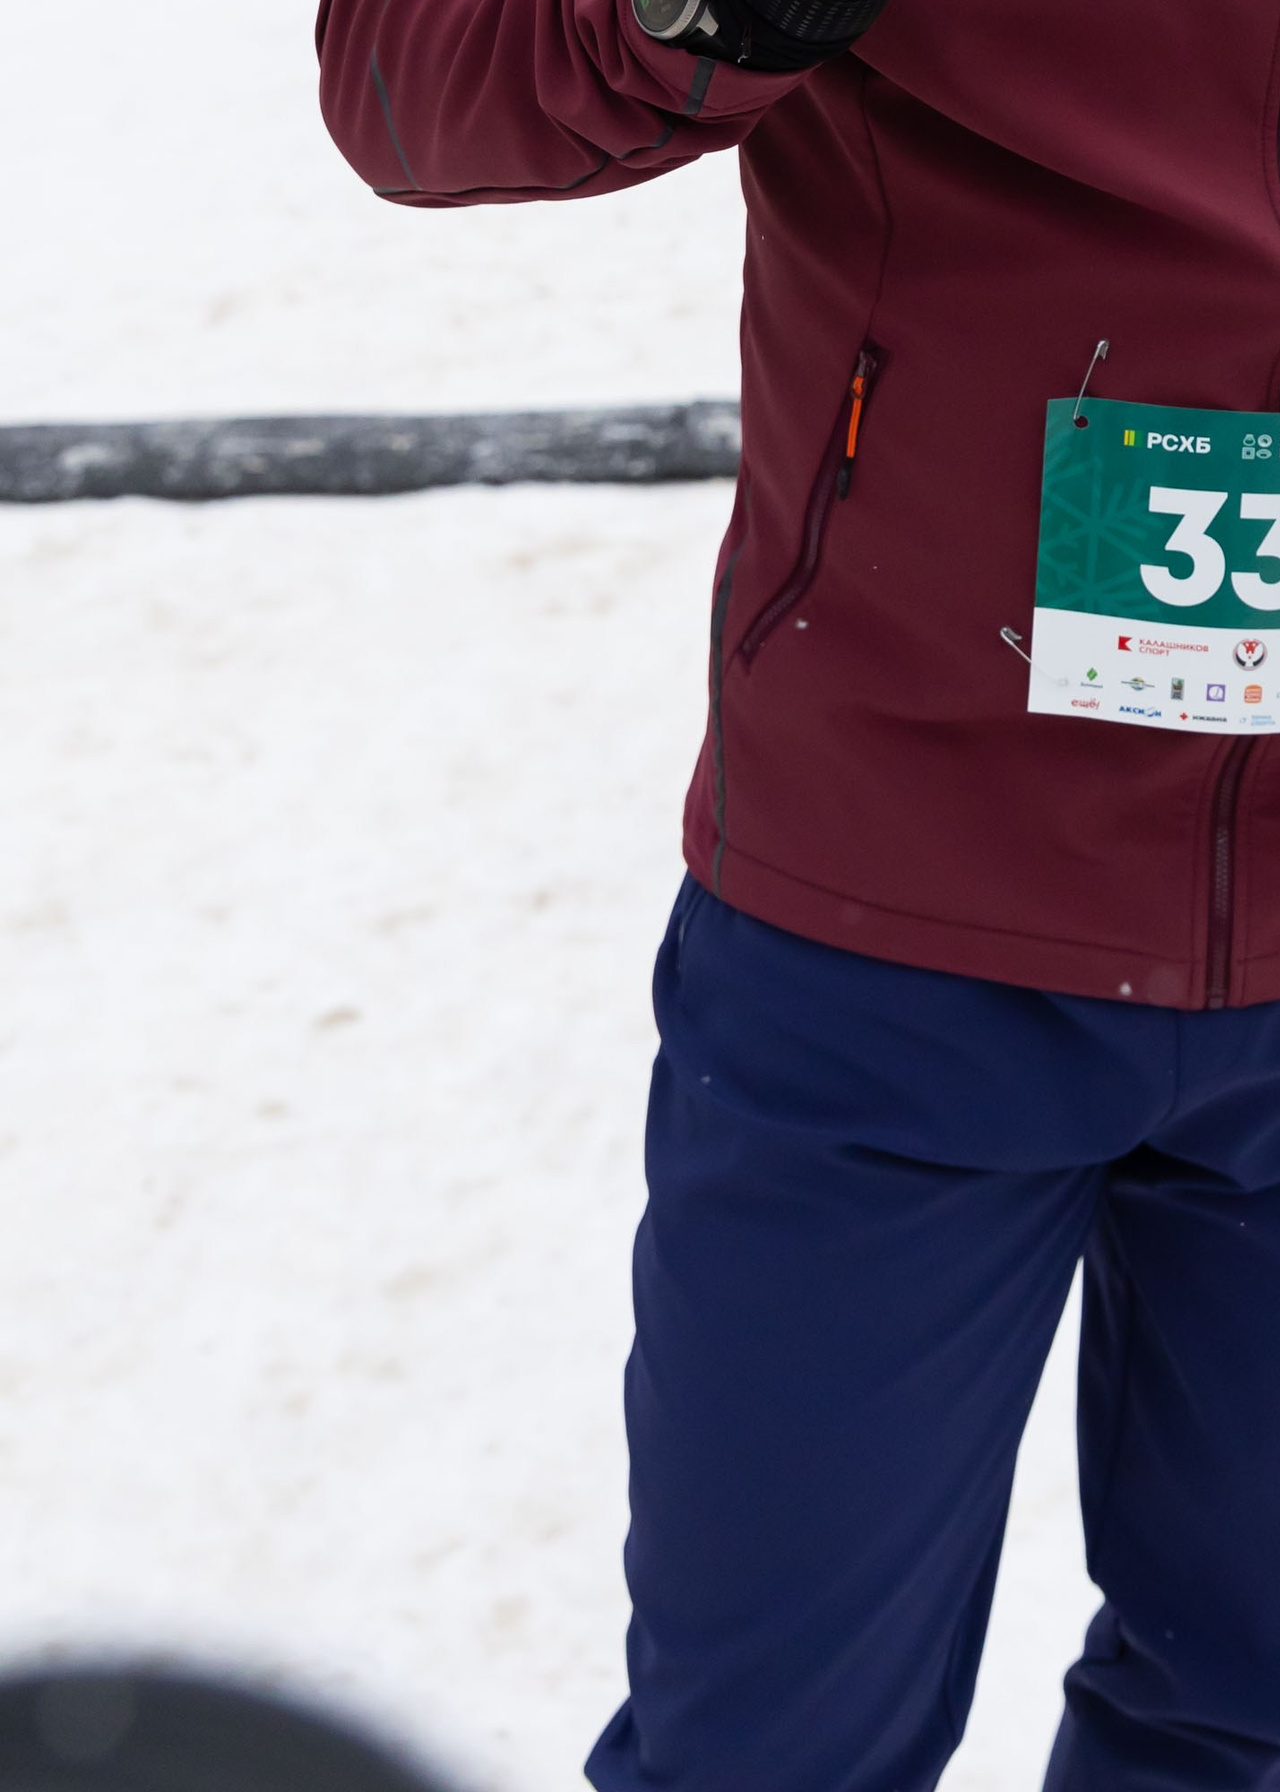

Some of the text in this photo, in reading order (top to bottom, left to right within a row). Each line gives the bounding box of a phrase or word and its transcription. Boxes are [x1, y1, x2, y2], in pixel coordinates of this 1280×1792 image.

[1146, 432, 1211, 454] РСХБ
[1138, 638, 1209, 653] КАЛАШНИКОВ
[1138, 646, 1170, 657] СПОРТ
